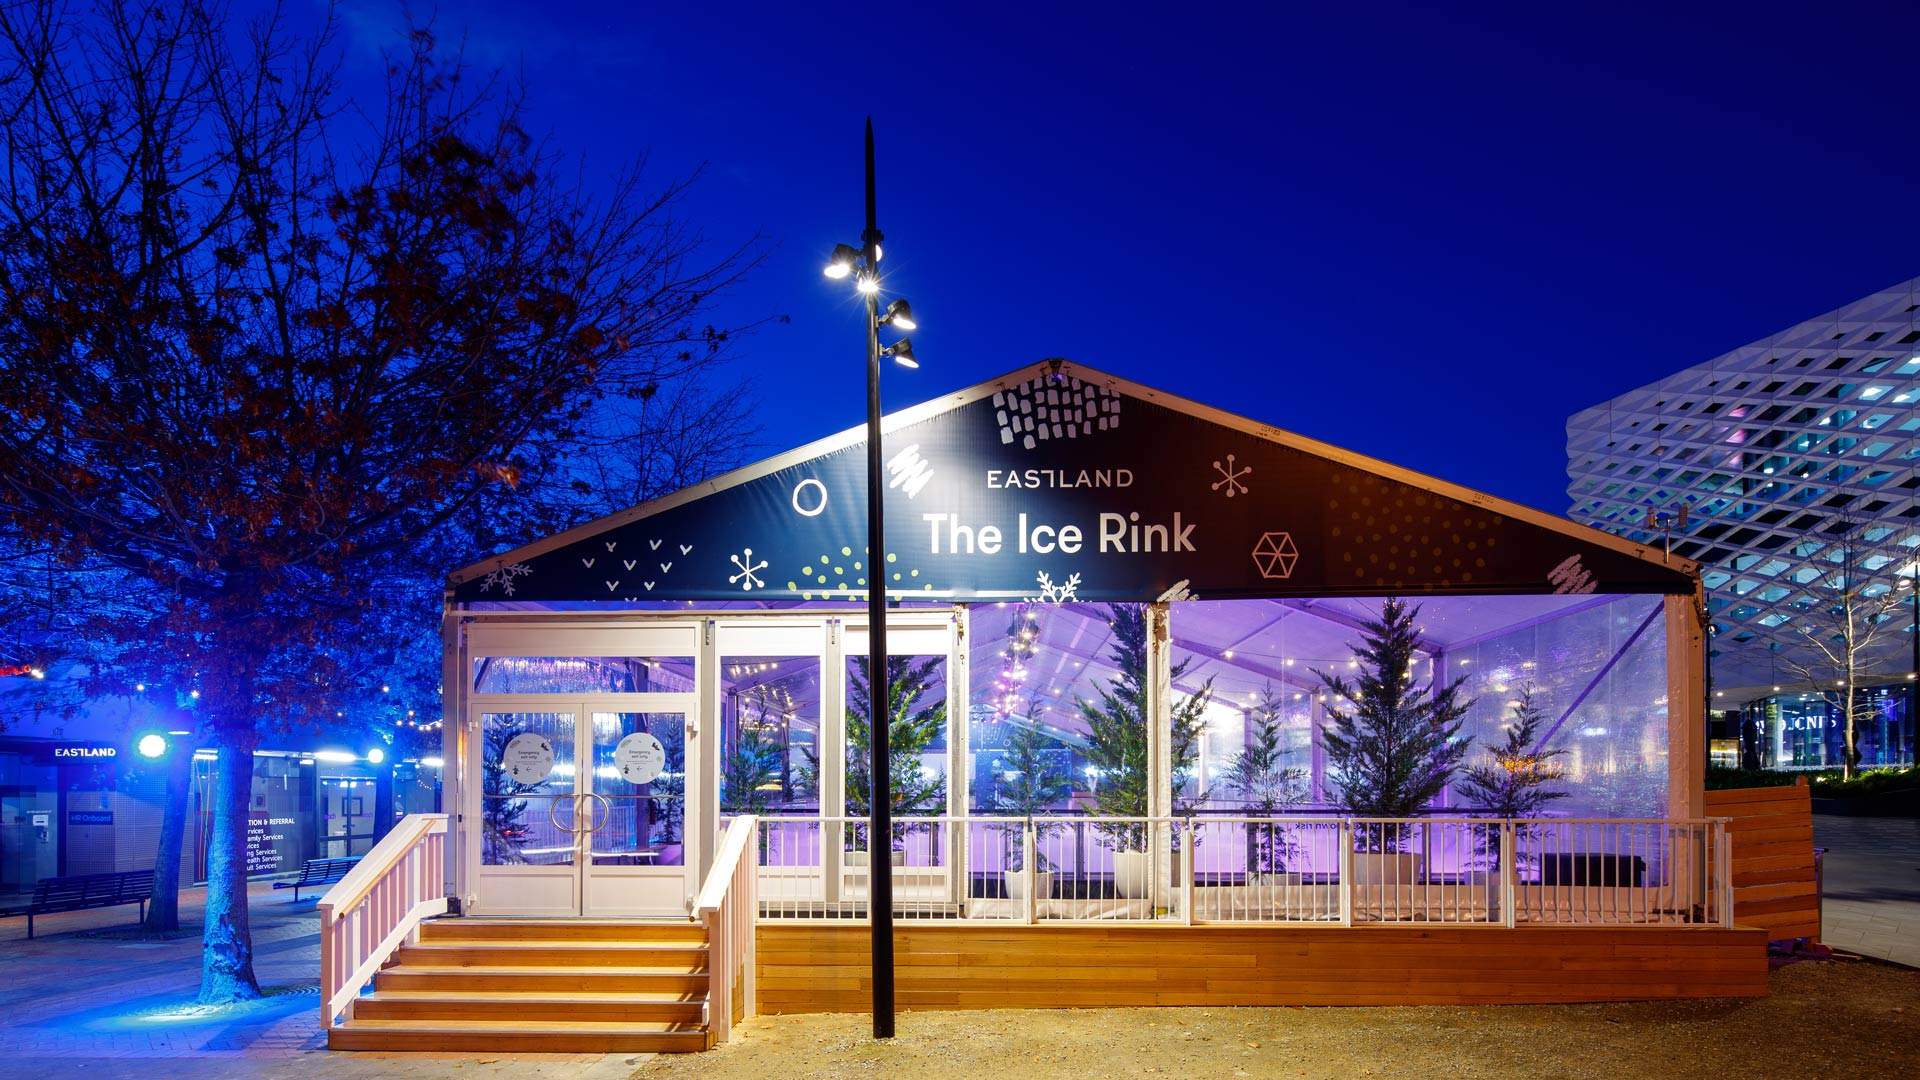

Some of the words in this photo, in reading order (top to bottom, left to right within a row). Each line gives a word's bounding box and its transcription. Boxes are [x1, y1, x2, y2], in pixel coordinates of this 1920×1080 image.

[987, 468, 1134, 489] EASTLAND
[922, 512, 1003, 555] The
[1018, 512, 1083, 555] Ice
[1099, 511, 1197, 553] Rink
[55, 748, 117, 757] EASTLAND
[269, 817, 295, 825] REFERRAL
[262, 833, 284, 841] Services
[255, 862, 277, 870] Services
